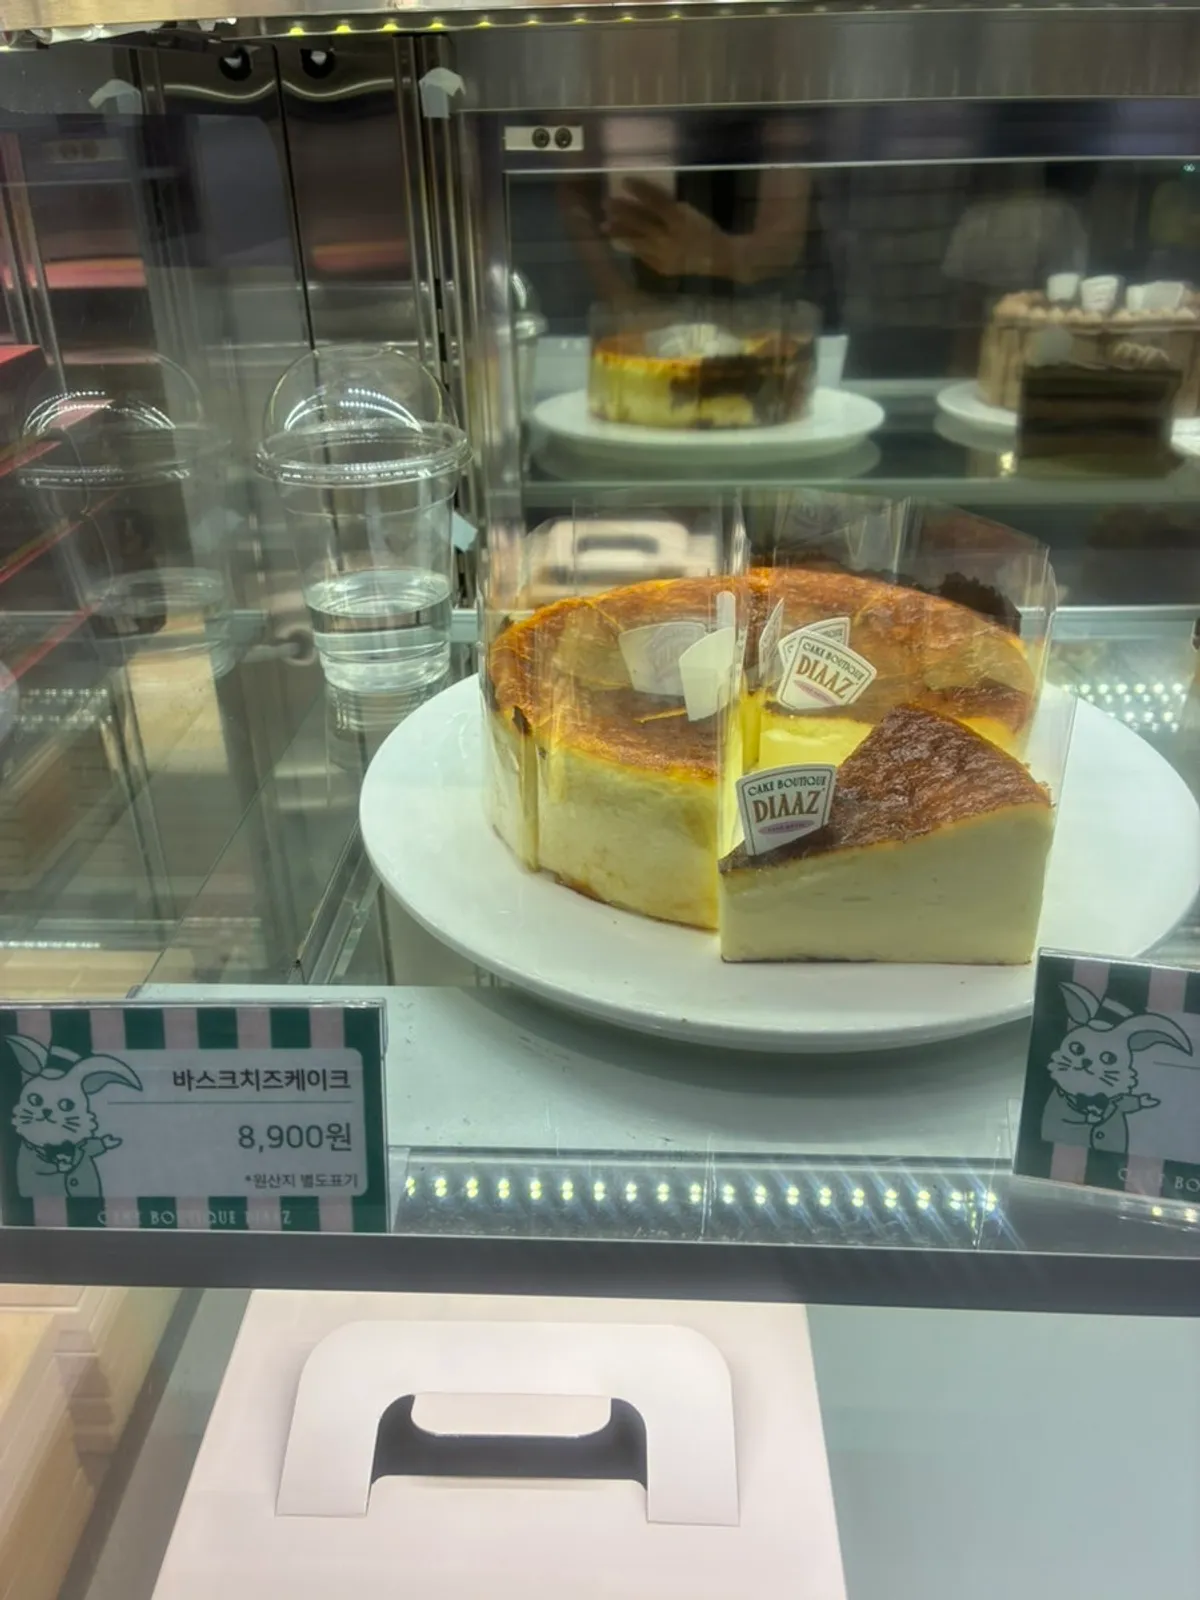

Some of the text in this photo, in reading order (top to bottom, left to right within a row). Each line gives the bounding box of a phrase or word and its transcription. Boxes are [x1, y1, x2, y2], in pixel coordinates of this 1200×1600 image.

[802, 641, 825, 658] CAKE
[796, 653, 853, 699] DIAAZ
[747, 775, 827, 796] CAKE BOUTIQUE
[752, 790, 821, 823] DIAAZ
[172, 1068, 351, 1092] 바스크치즈케이크
[237, 1122, 352, 1153] 8,900원
[301, 1173, 358, 1189] 별도표기
